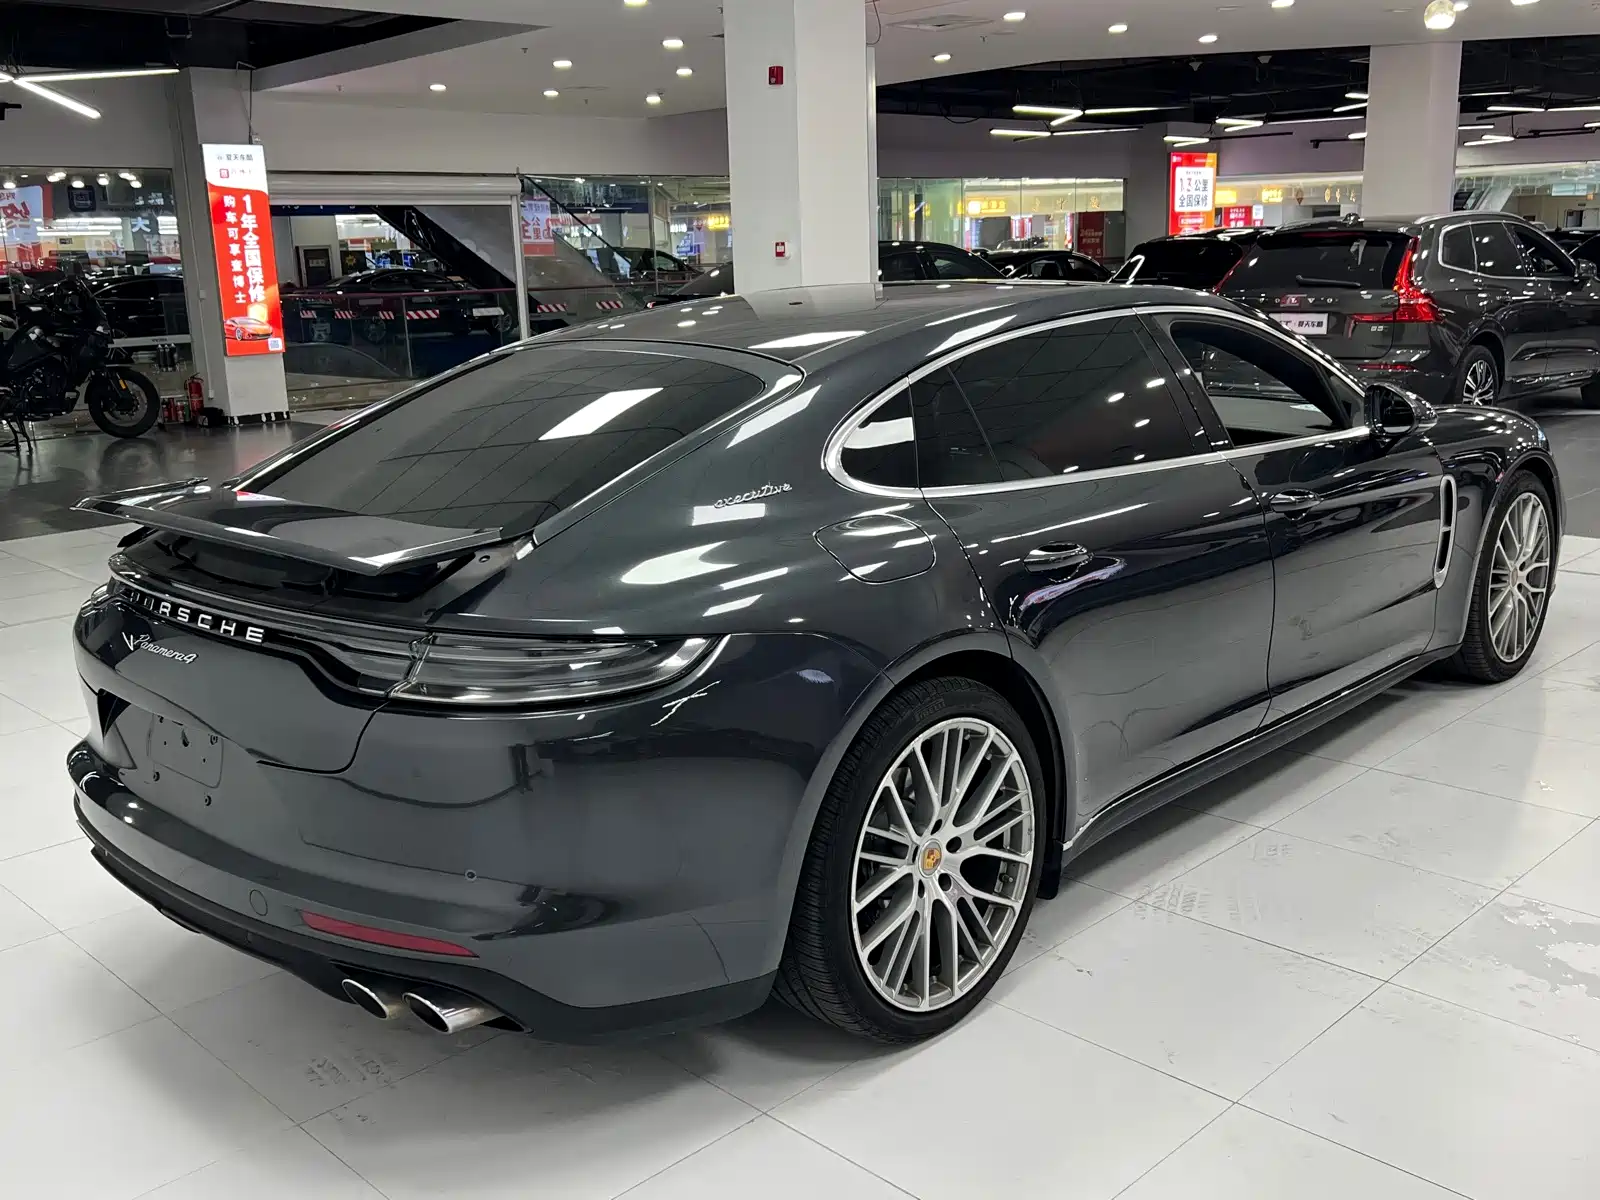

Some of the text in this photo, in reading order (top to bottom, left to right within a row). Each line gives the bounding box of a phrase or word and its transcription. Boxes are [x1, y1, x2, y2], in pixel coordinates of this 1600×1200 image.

[1179, 194, 1209, 208] 全国保修
[223, 195, 247, 304] 购车可享查博士
[240, 194, 266, 303] 1年全国保修
[714, 482, 793, 508] executive
